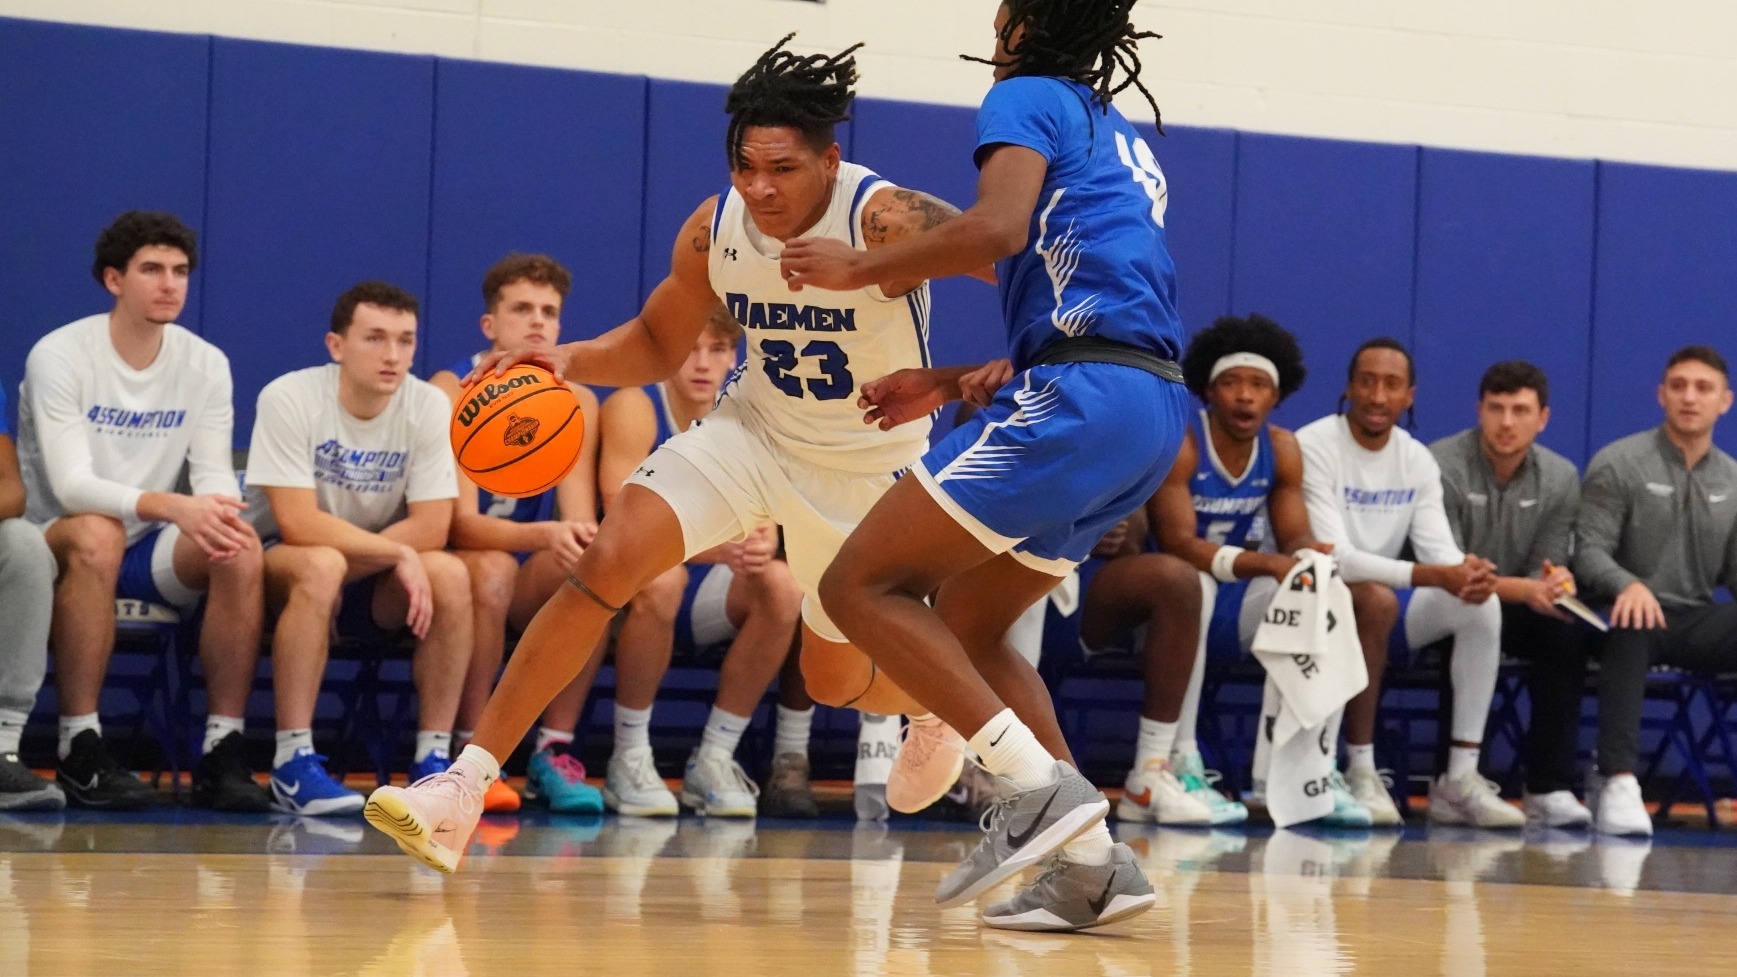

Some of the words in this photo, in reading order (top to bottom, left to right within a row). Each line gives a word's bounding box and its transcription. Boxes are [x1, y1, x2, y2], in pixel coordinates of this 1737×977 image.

[725, 292, 858, 332] DAEMEN
[759, 338, 854, 401] 23
[87, 404, 186, 429] ASSUMPTION
[457, 374, 541, 427] Wilson
